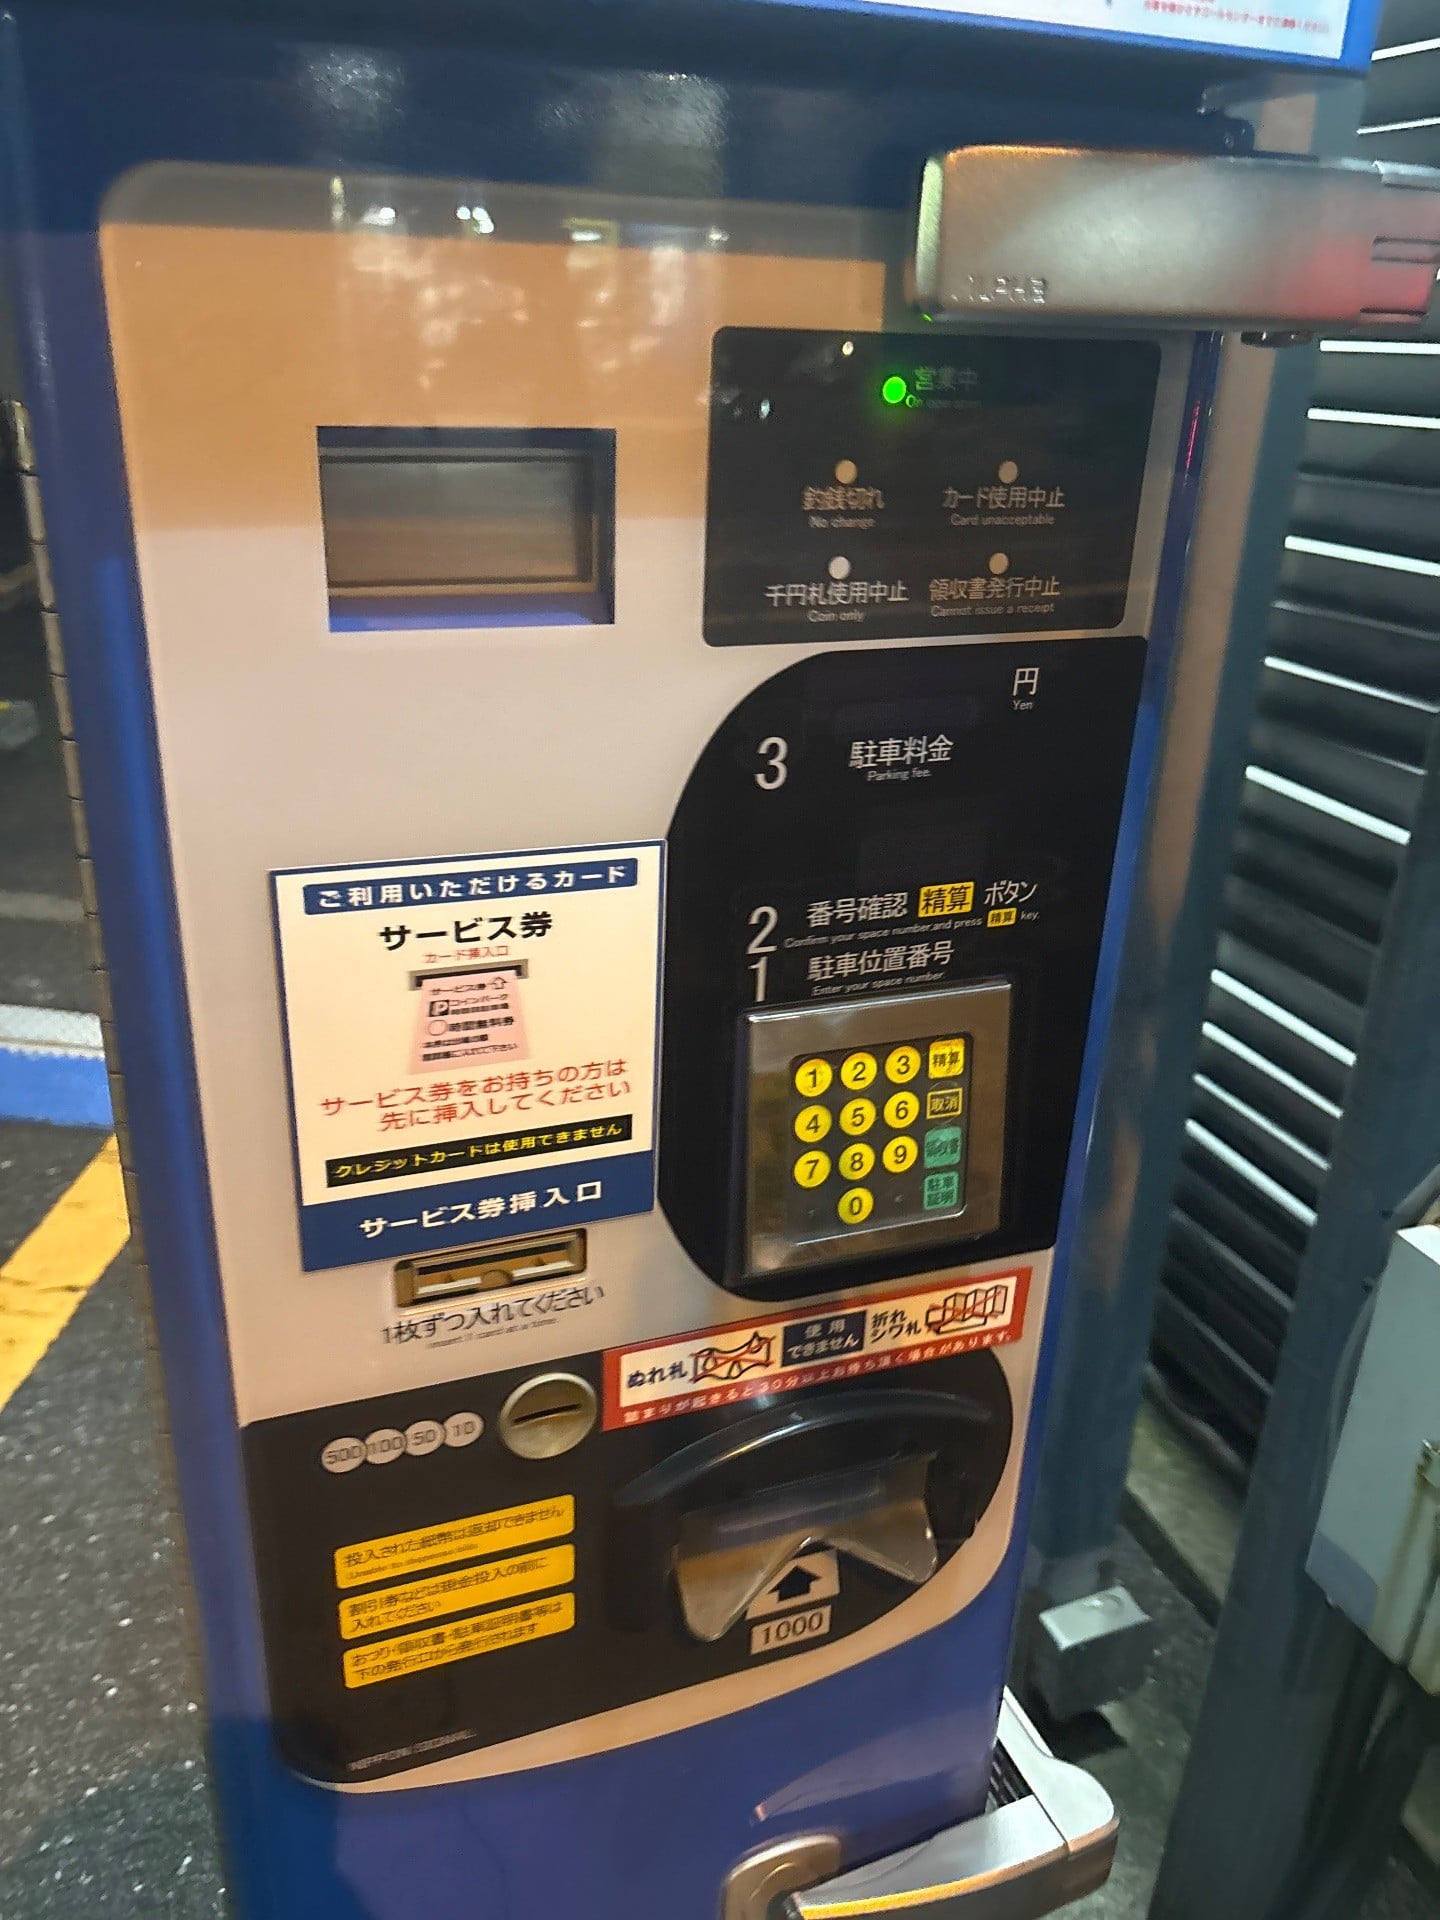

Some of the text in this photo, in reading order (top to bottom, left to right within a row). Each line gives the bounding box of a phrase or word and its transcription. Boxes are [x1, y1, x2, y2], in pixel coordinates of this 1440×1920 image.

[942, 486, 1065, 509] カード使用中止
[765, 580, 909, 607] 千円札使用中止
[929, 576, 1060, 601] 領収書発行中止
[1012, 667, 1040, 697] 円
[1013, 700, 1033, 711] Yen
[754, 736, 789, 790] 3
[848, 734, 954, 769] 駐車料金
[318, 866, 627, 908] ご利用いただけるカード
[806, 879, 1038, 928] 番号確認 精算 ボタン
[379, 911, 553, 951] サービス券
[747, 905, 778, 955] 2
[807, 940, 955, 981] 駐車位置番号
[747, 956, 768, 1002] 1
[808, 1069, 817, 1087] 1
[852, 1061, 866, 1082] 2
[897, 1056, 909, 1074] 3
[321, 1058, 628, 1116] サービス券をお持ちの方は
[378, 1081, 630, 1131] 先に挿入してください
[851, 1107, 864, 1126] 5
[896, 1101, 908, 1119] 6
[806, 1114, 820, 1133] 4
[334, 1124, 623, 1178] クレジットカードは使用できません
[851, 1154, 863, 1171] 8
[895, 1145, 906, 1163] 9
[806, 1159, 820, 1179] 7
[359, 1181, 602, 1238] サービス券挿入口
[850, 1196, 862, 1216] 0
[382, 1286, 605, 1344] 1枚ずつ入れてください
[871, 1309, 906, 1329] 折れ
[787, 1334, 860, 1359] できません
[626, 1360, 688, 1388] ぬれ札
[325, 1420, 475, 1465] 500 100 50 10
[763, 1612, 823, 1645] 1000
